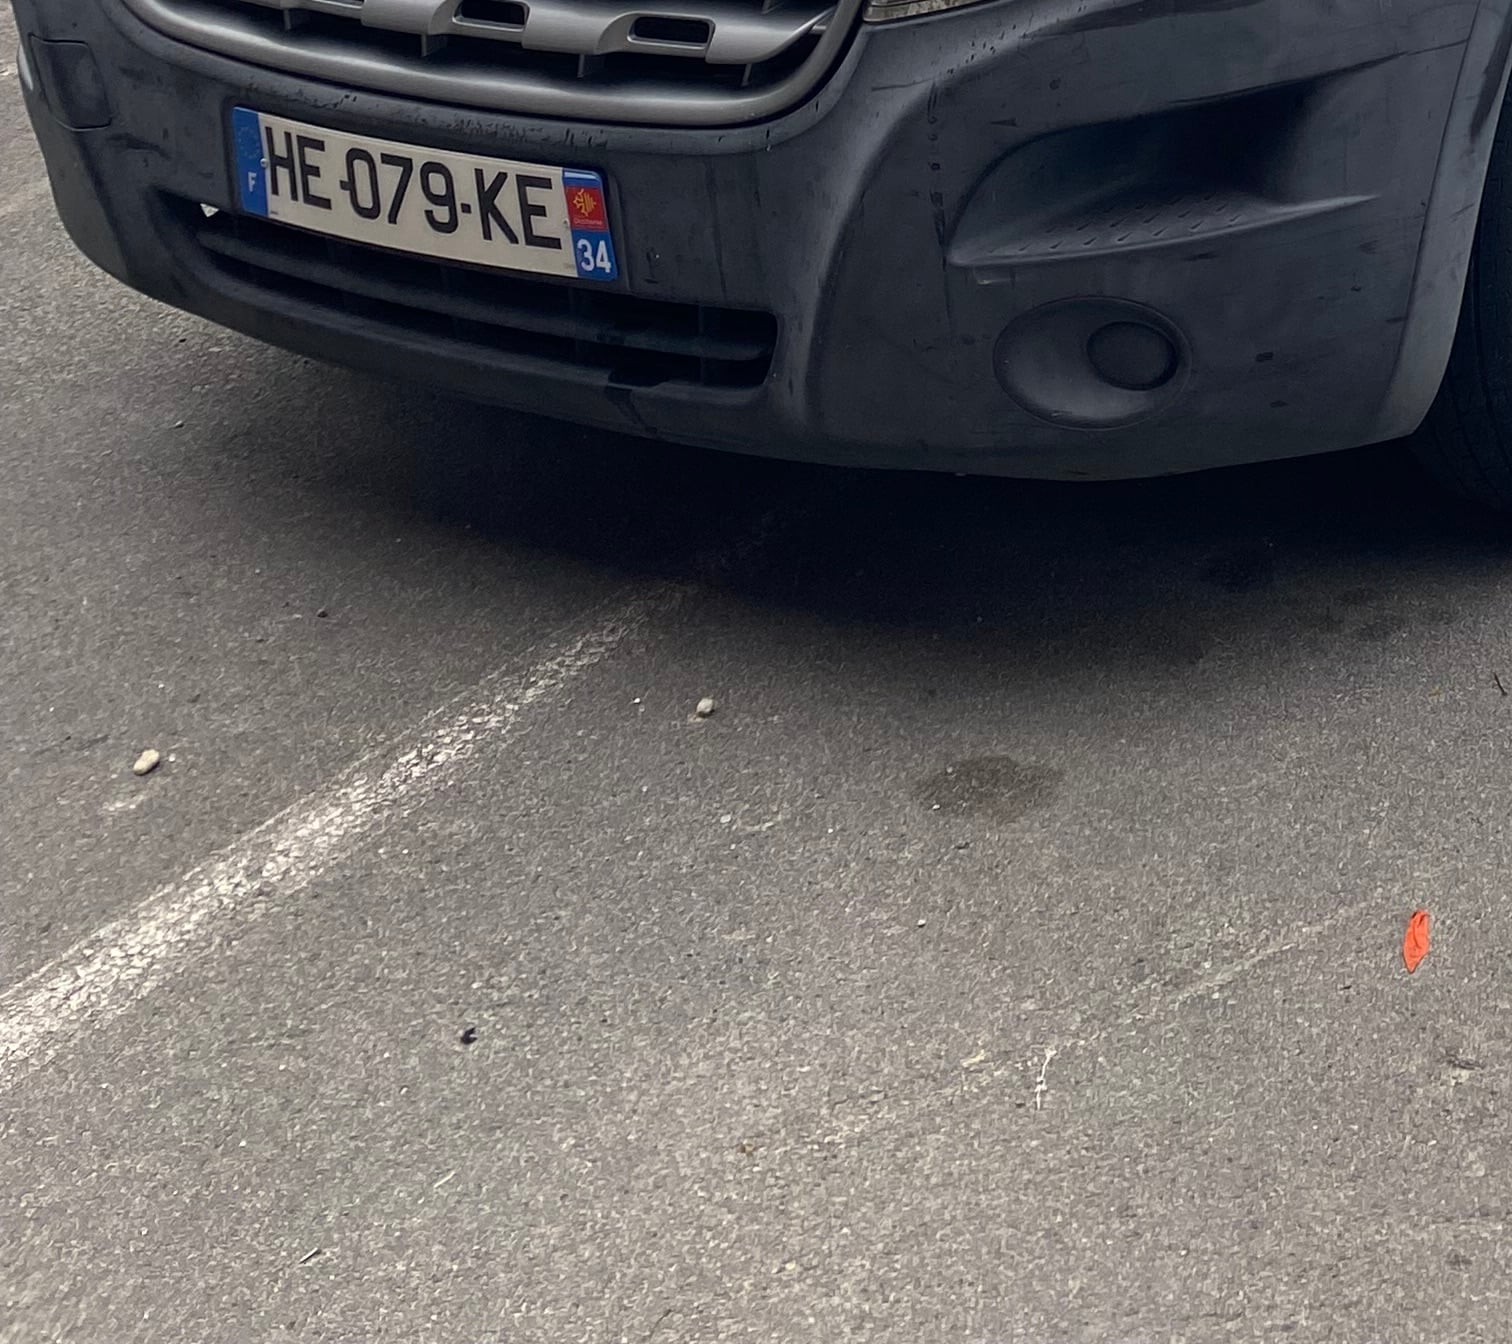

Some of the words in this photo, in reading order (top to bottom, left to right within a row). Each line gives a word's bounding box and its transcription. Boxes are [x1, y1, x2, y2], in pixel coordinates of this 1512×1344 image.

[247, 171, 257, 192] F
[264, 126, 562, 250] HE-079-KE
[577, 238, 612, 273] 34
